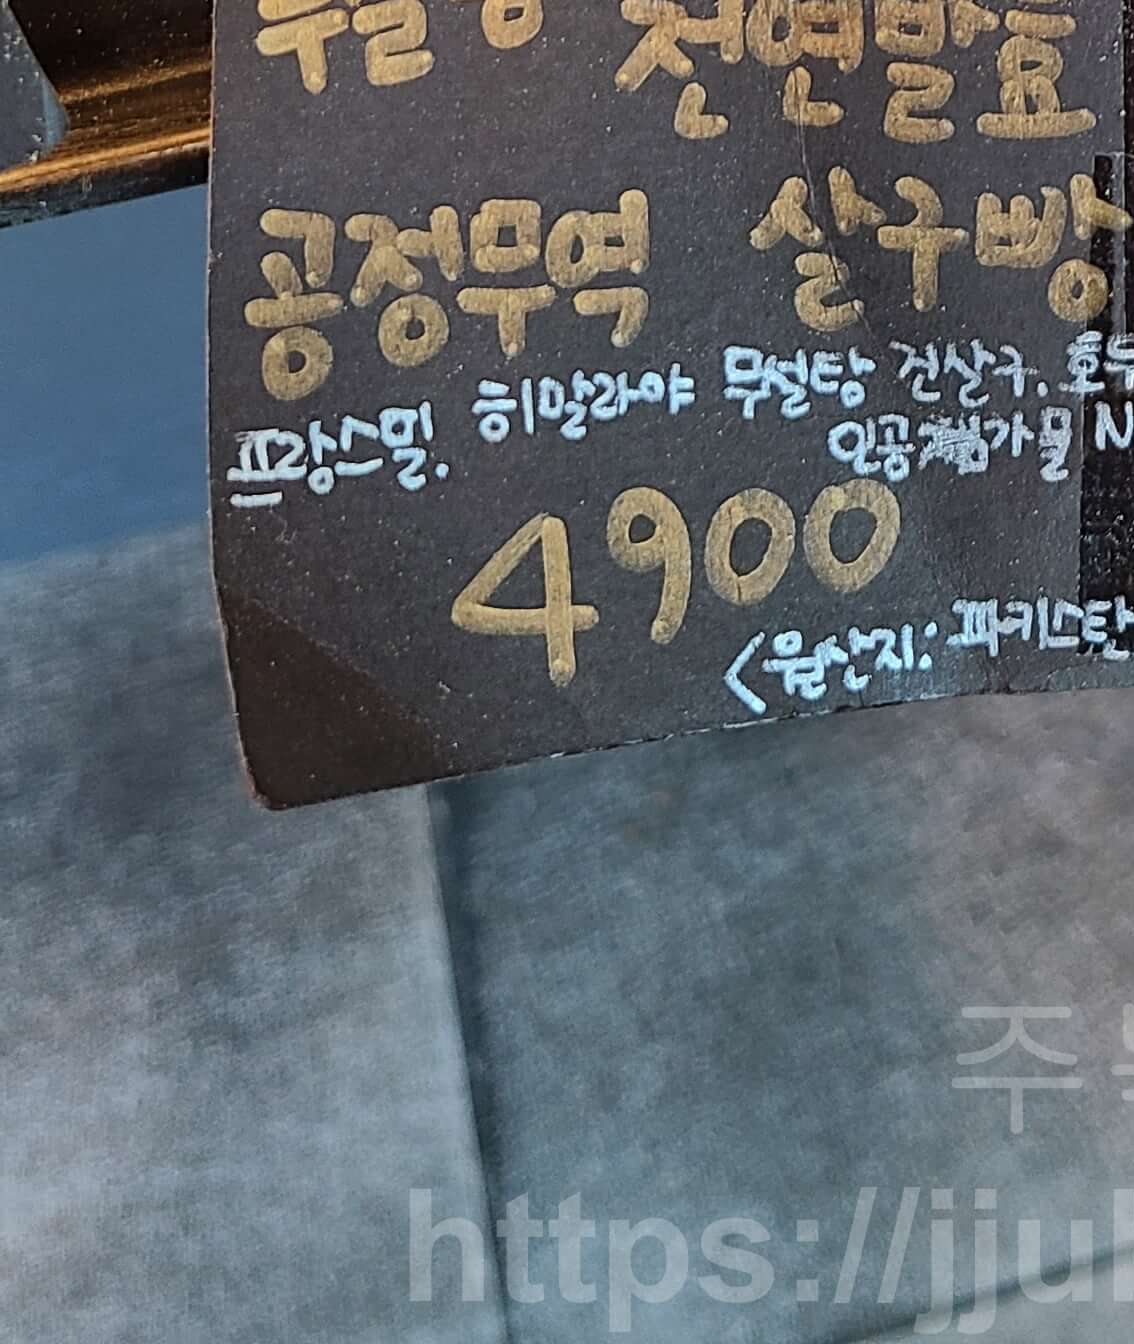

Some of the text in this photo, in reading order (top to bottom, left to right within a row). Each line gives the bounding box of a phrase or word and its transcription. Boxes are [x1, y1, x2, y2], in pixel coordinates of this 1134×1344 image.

[244, 165, 1134, 401] 공정무역 살구빵
[471, 362, 696, 443] 히말라야
[722, 343, 876, 420] 무설탕
[450, 477, 903, 688] 4900
